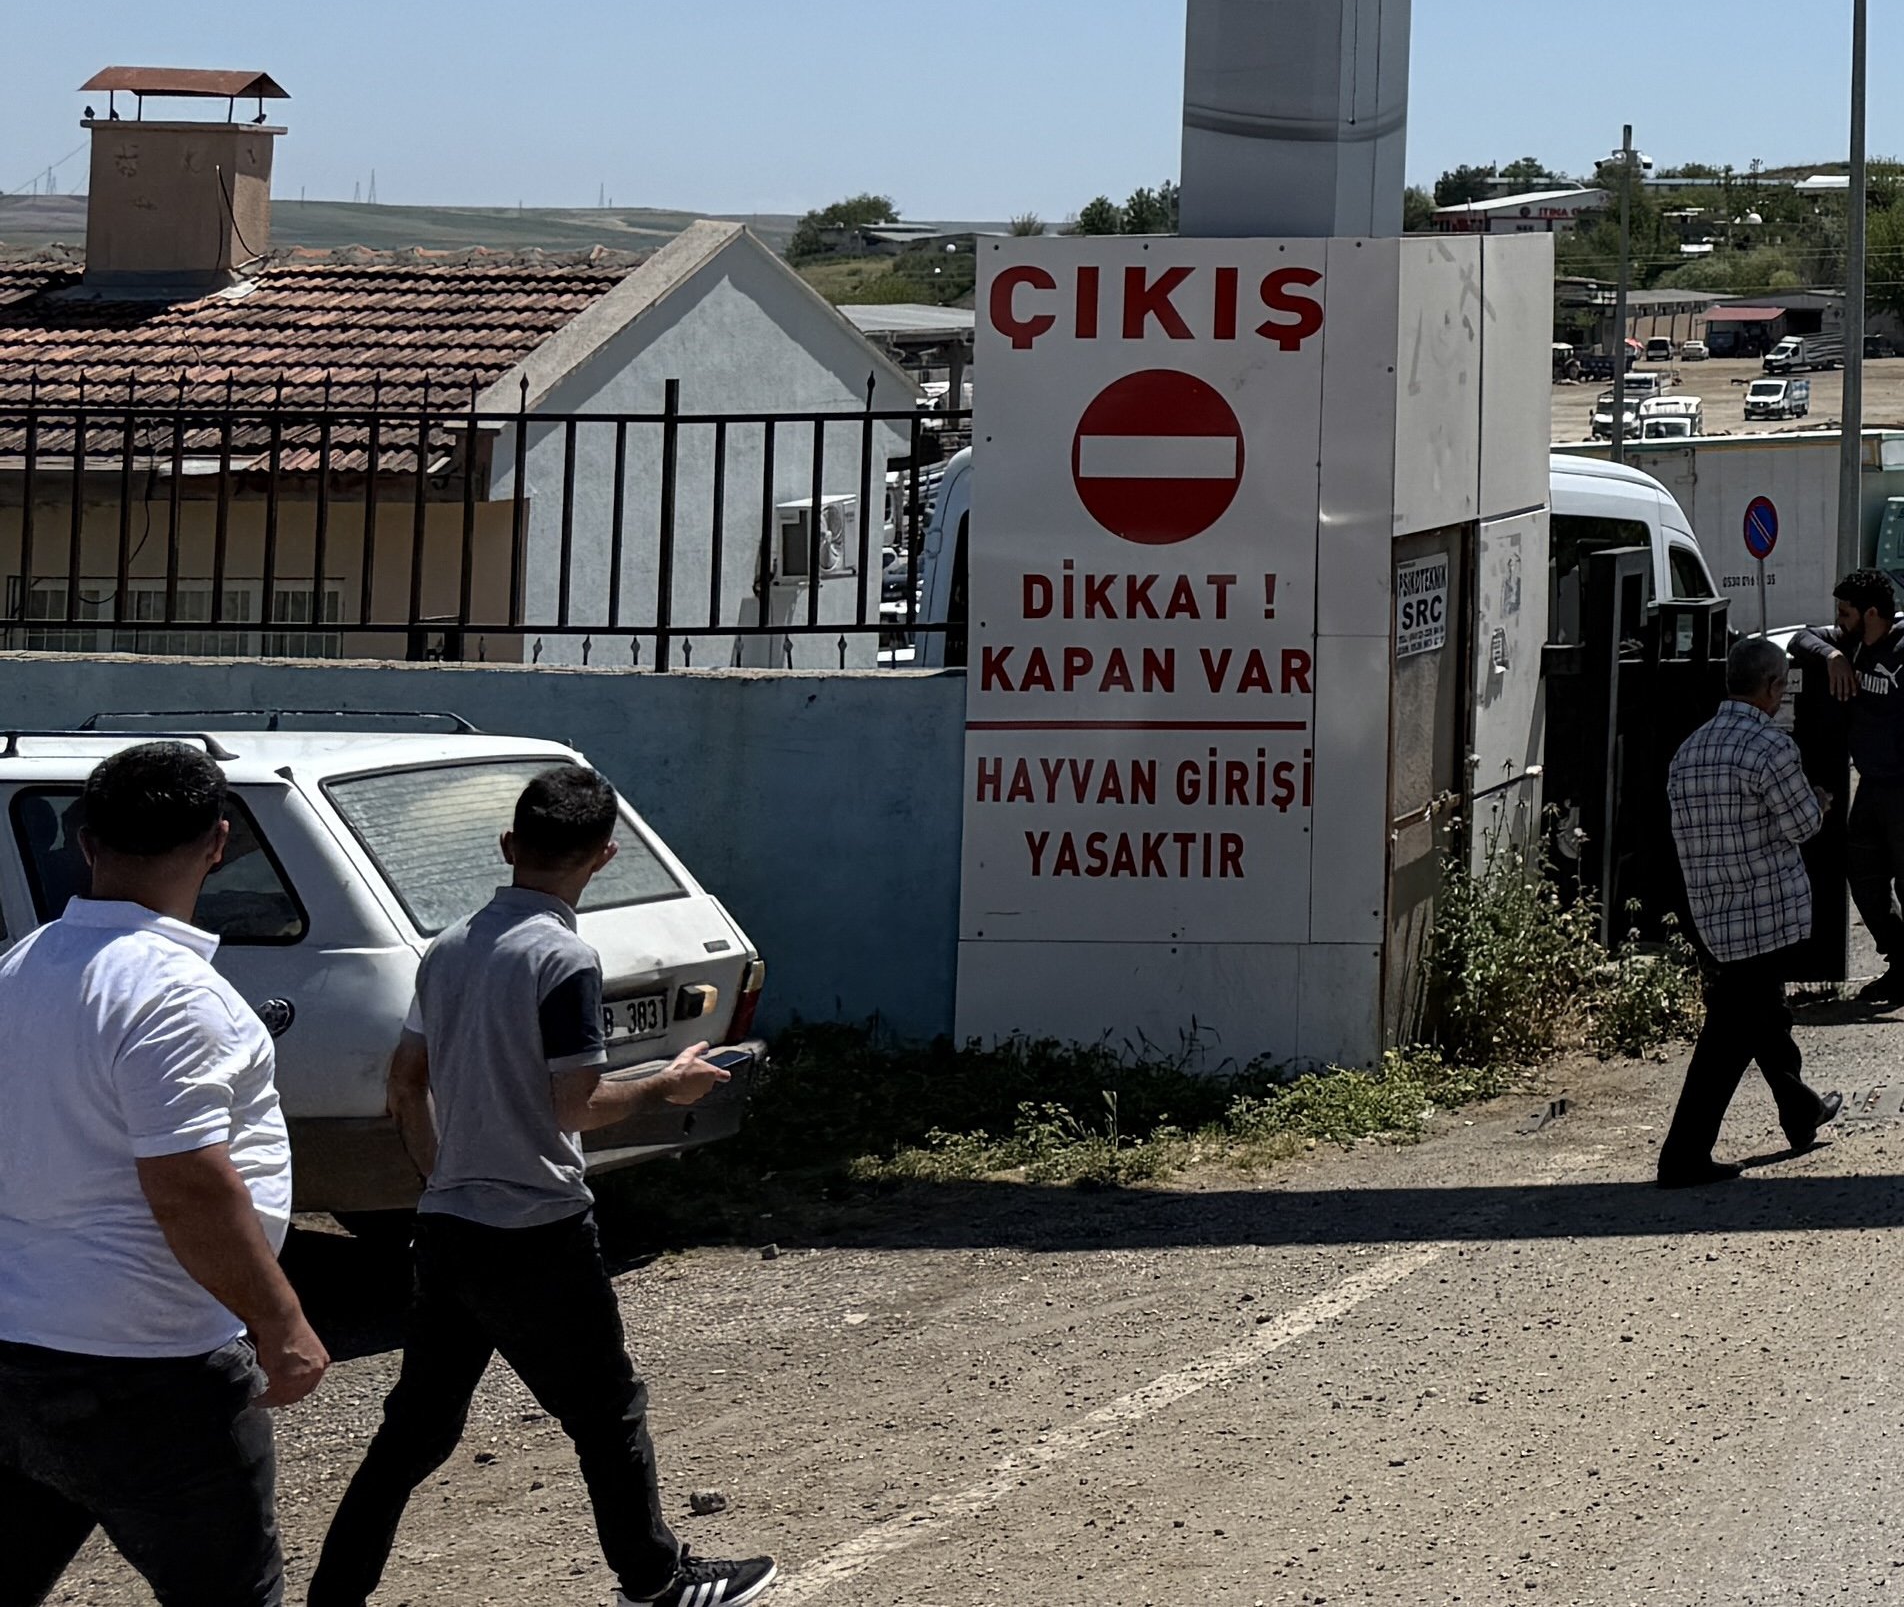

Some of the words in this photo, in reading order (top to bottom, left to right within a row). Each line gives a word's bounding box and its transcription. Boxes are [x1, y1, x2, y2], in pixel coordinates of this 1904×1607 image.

[989, 265, 1324, 351] ÇIKIŞ
[1022, 559, 1237, 619] DİKKAT
[1401, 594, 1443, 631] SRC
[980, 646, 1176, 694] KAPAN
[1200, 647, 1314, 695] VAR
[976, 755, 1158, 806] HAYVAN
[1175, 747, 1314, 813] GİRİŞİ
[1025, 831, 1246, 879] YASAKTIR
